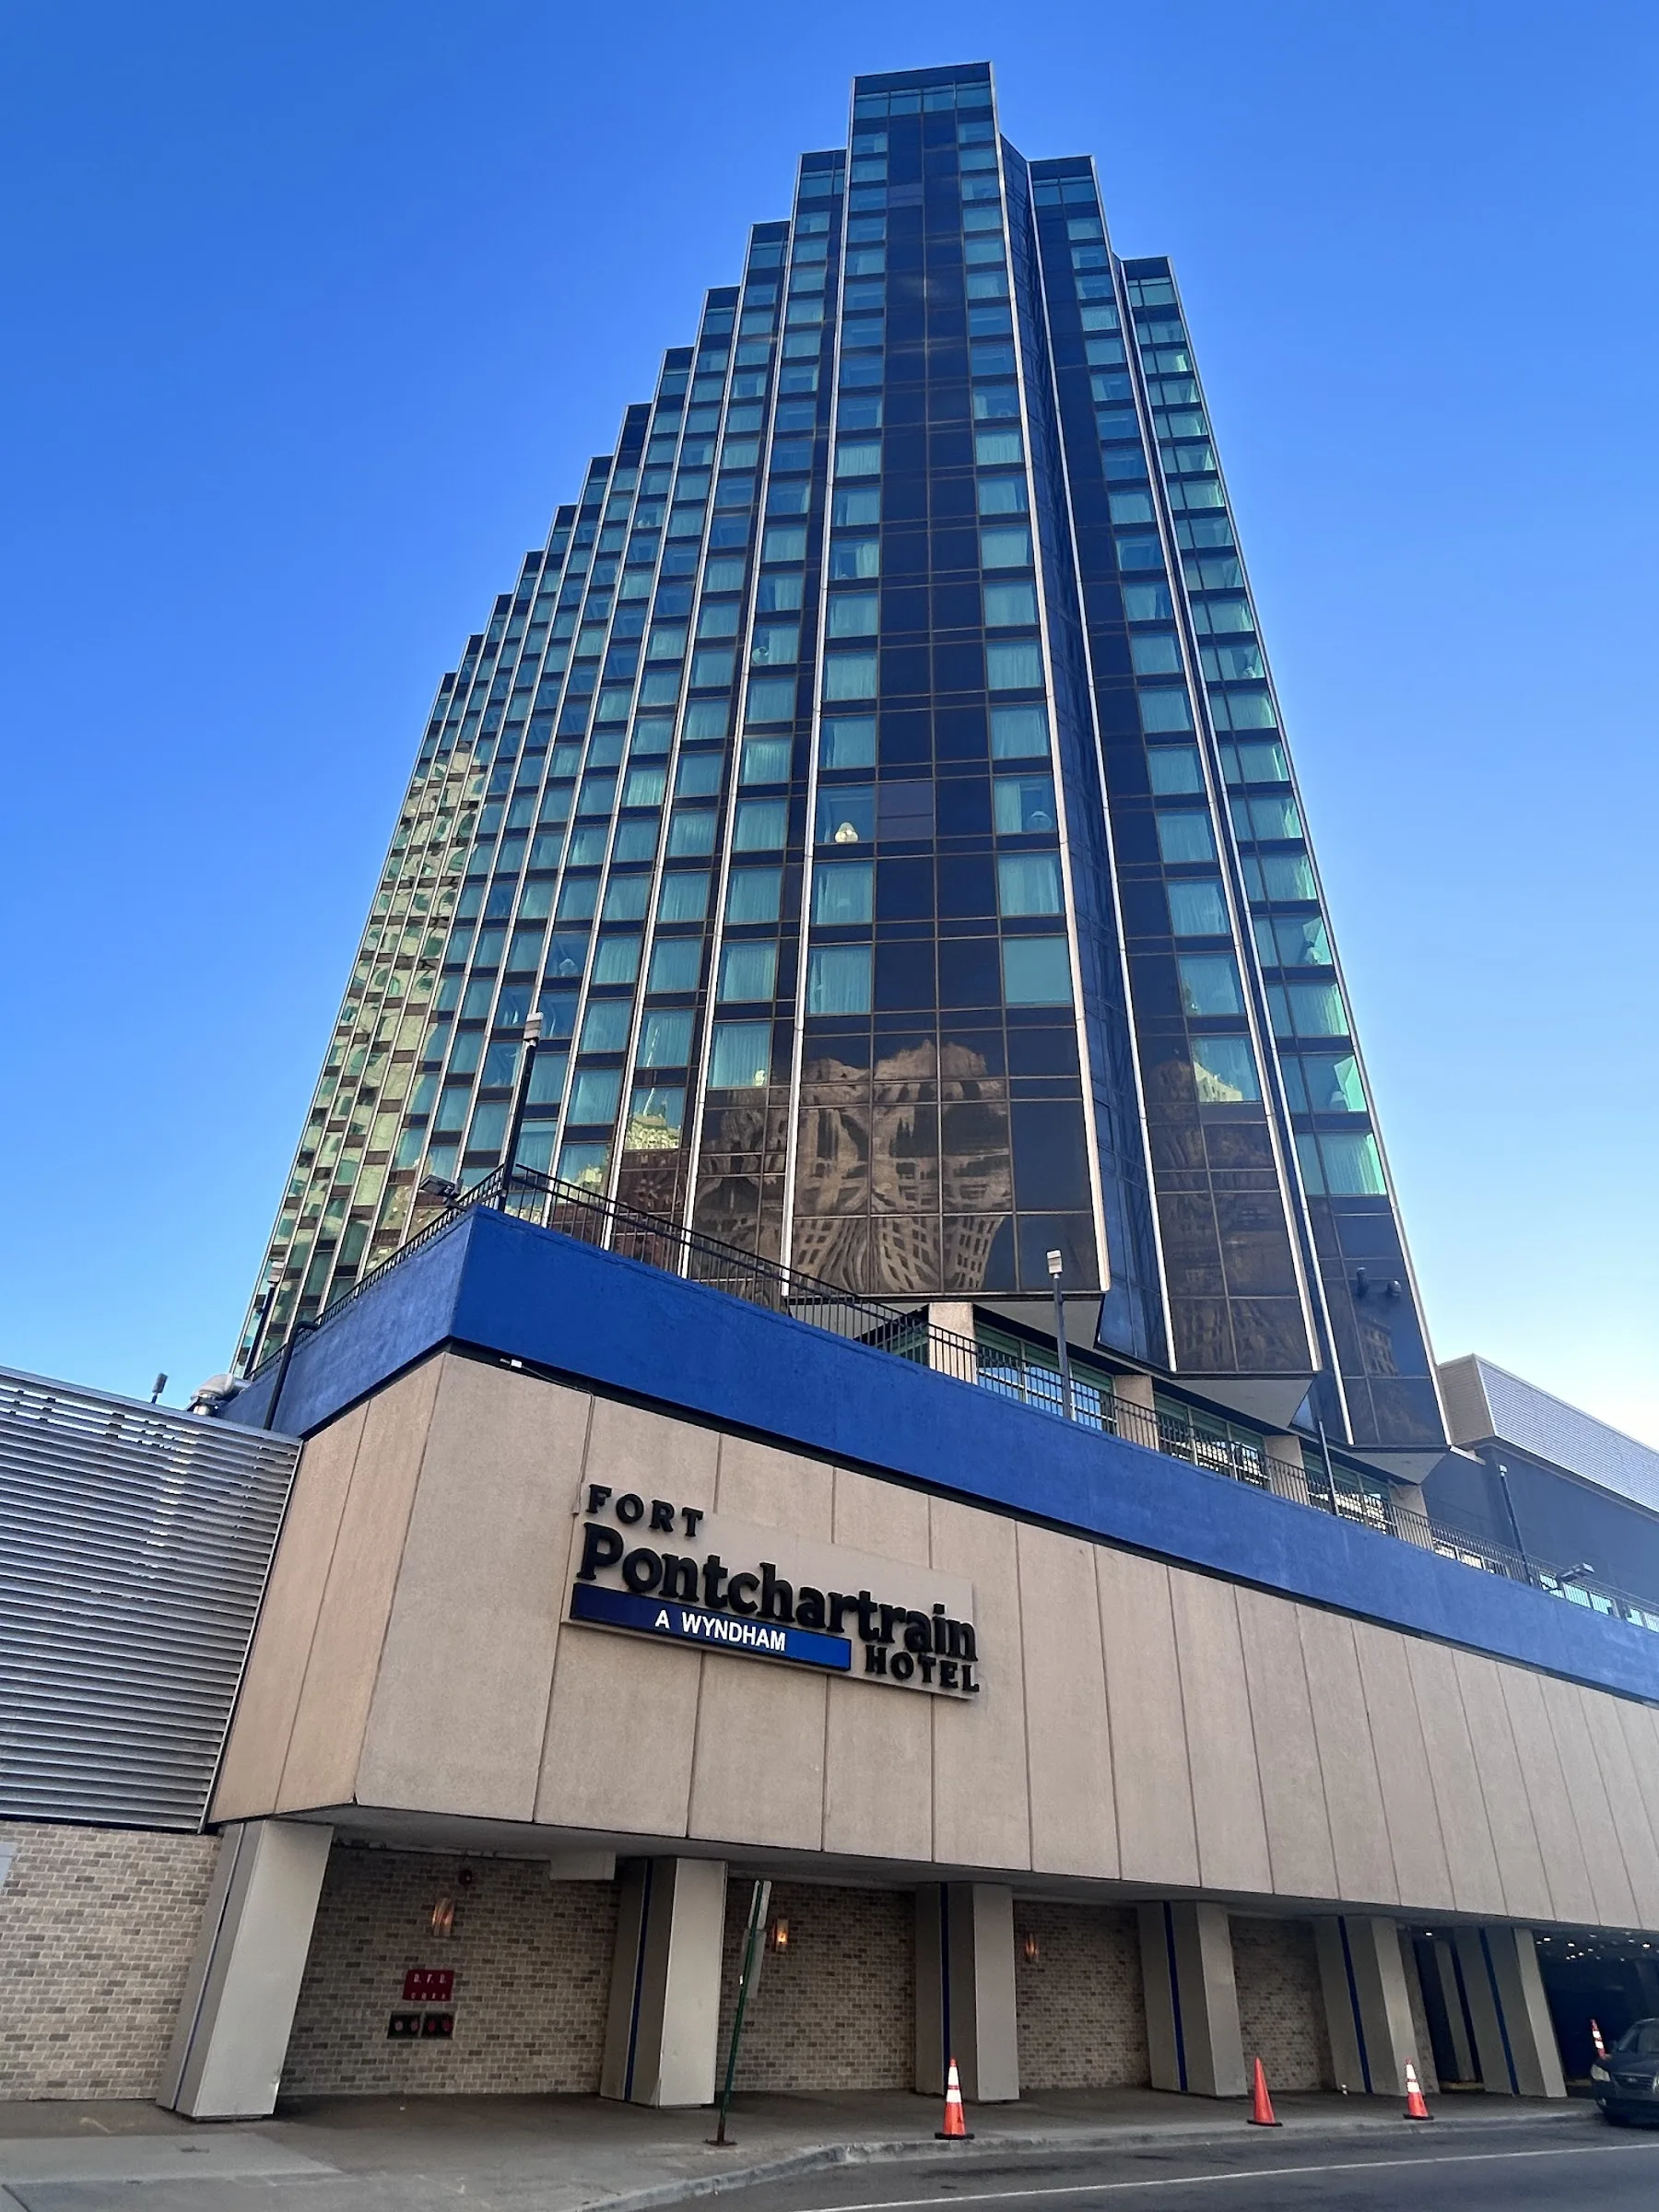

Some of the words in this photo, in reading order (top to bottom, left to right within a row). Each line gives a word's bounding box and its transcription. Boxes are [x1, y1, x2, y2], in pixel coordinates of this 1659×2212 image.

[585, 1483, 704, 1537] FORT
[576, 1521, 979, 1663] Pontchartrain
[654, 1609, 670, 1630] A
[681, 1610, 786, 1652] WYNDHAM
[865, 1644, 981, 1692] HOTEL
